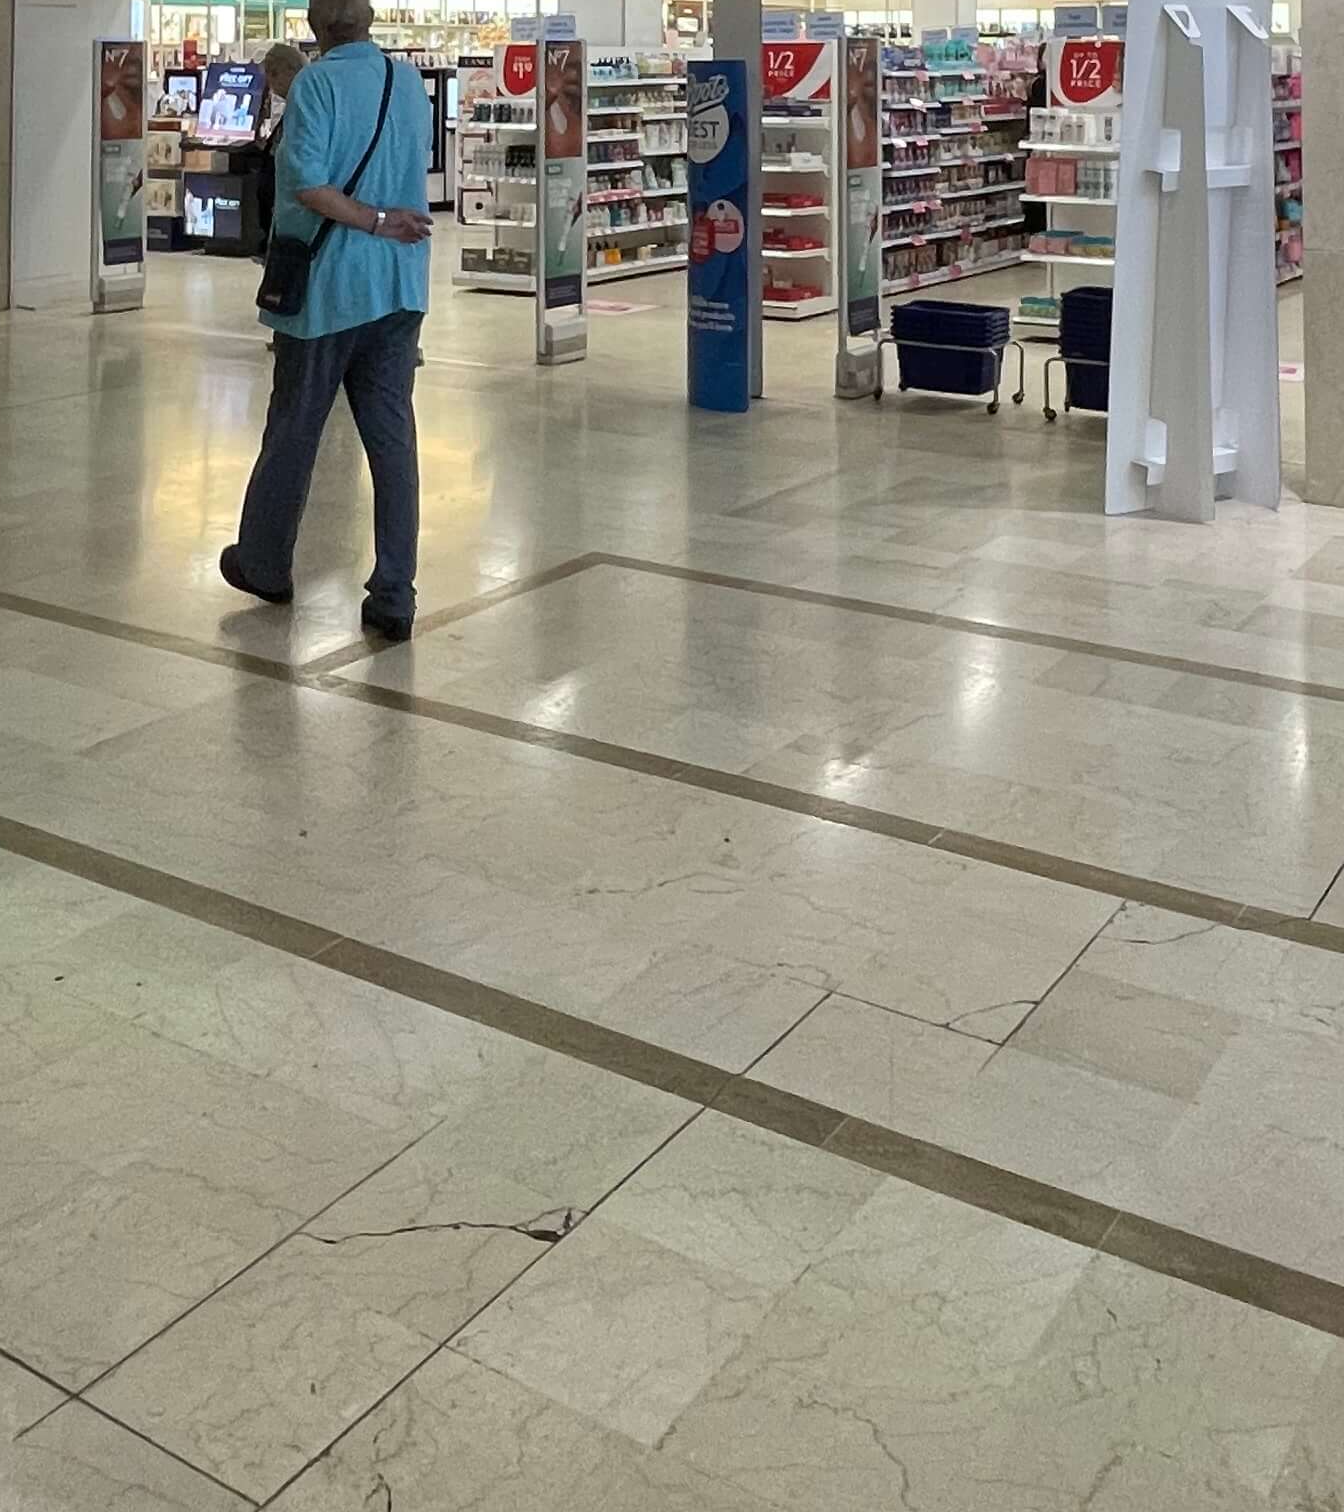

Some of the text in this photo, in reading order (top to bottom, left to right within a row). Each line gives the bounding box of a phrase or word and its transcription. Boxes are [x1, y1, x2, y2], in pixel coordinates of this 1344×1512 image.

[464, 58, 492, 66] LANC
[768, 51, 794, 69] 1/2
[1070, 59, 1101, 79] 1/2
[768, 70, 795, 78] PRICE
[1071, 80, 1102, 88] PRICE
